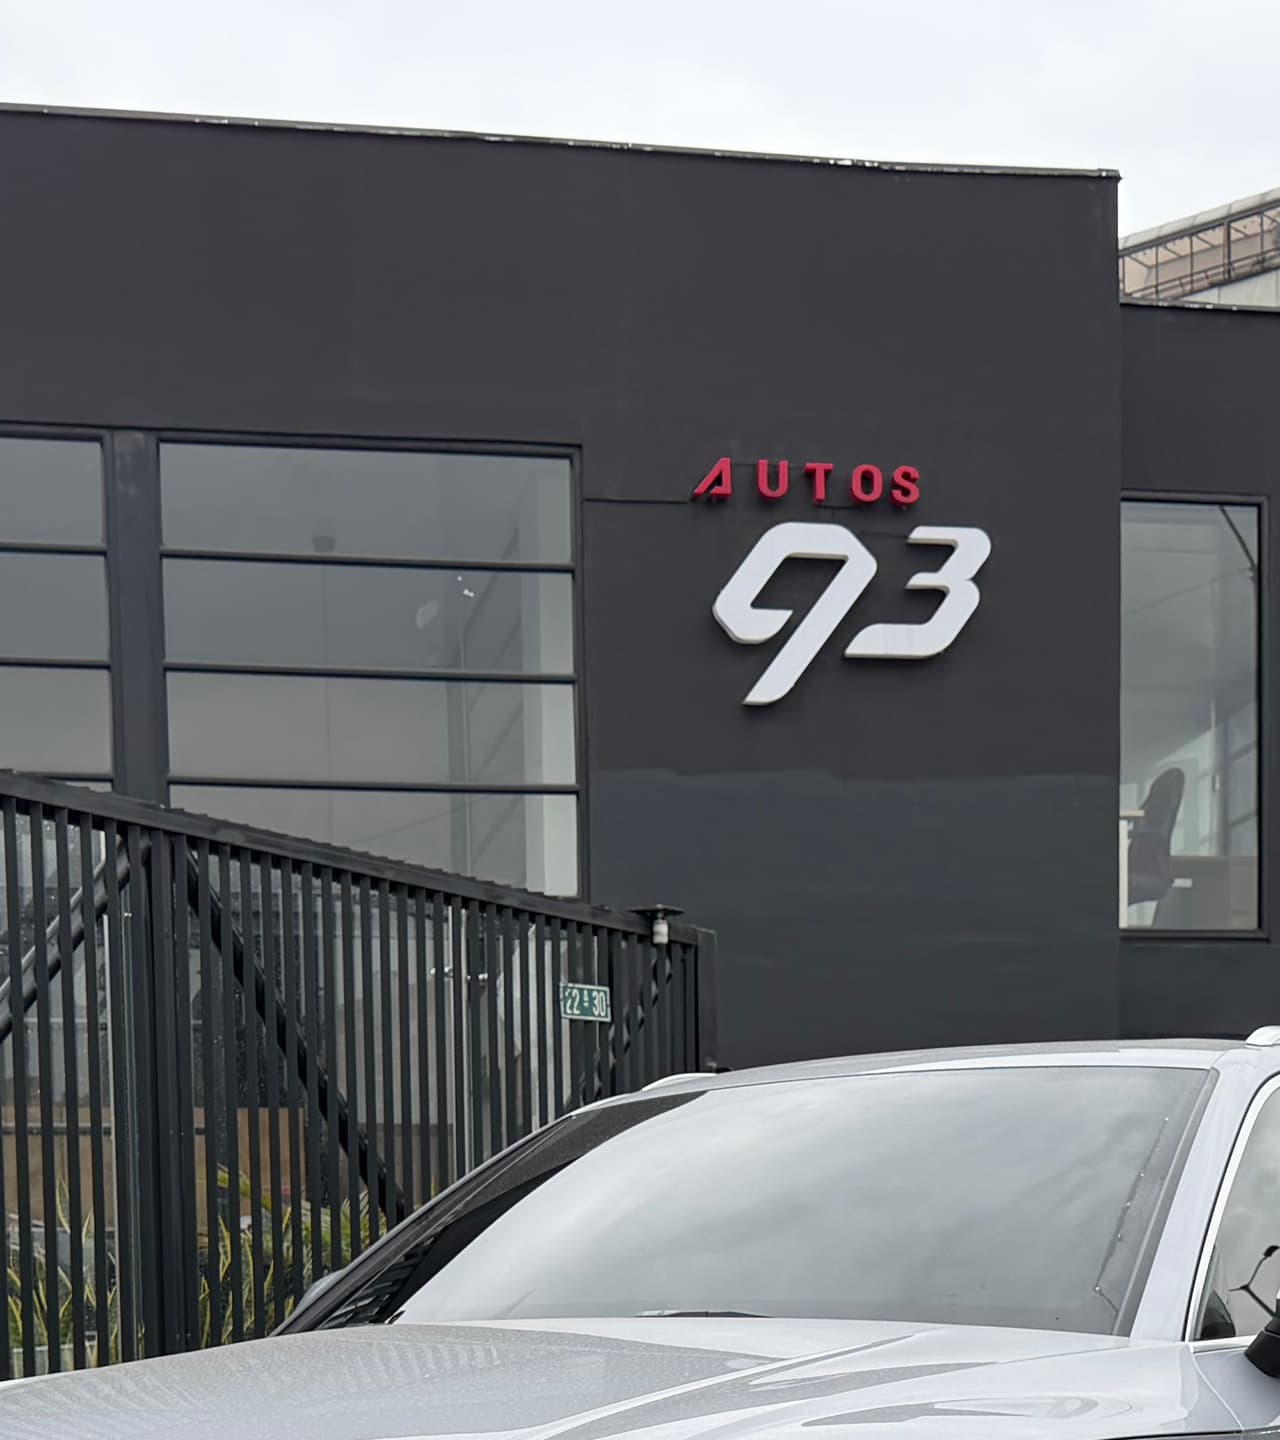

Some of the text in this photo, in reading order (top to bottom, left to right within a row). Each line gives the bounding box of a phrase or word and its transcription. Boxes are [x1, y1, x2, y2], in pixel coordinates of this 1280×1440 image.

[692, 456, 921, 506] AUTOS
[711, 520, 993, 707] 93
[591, 990, 607, 1017] 30
